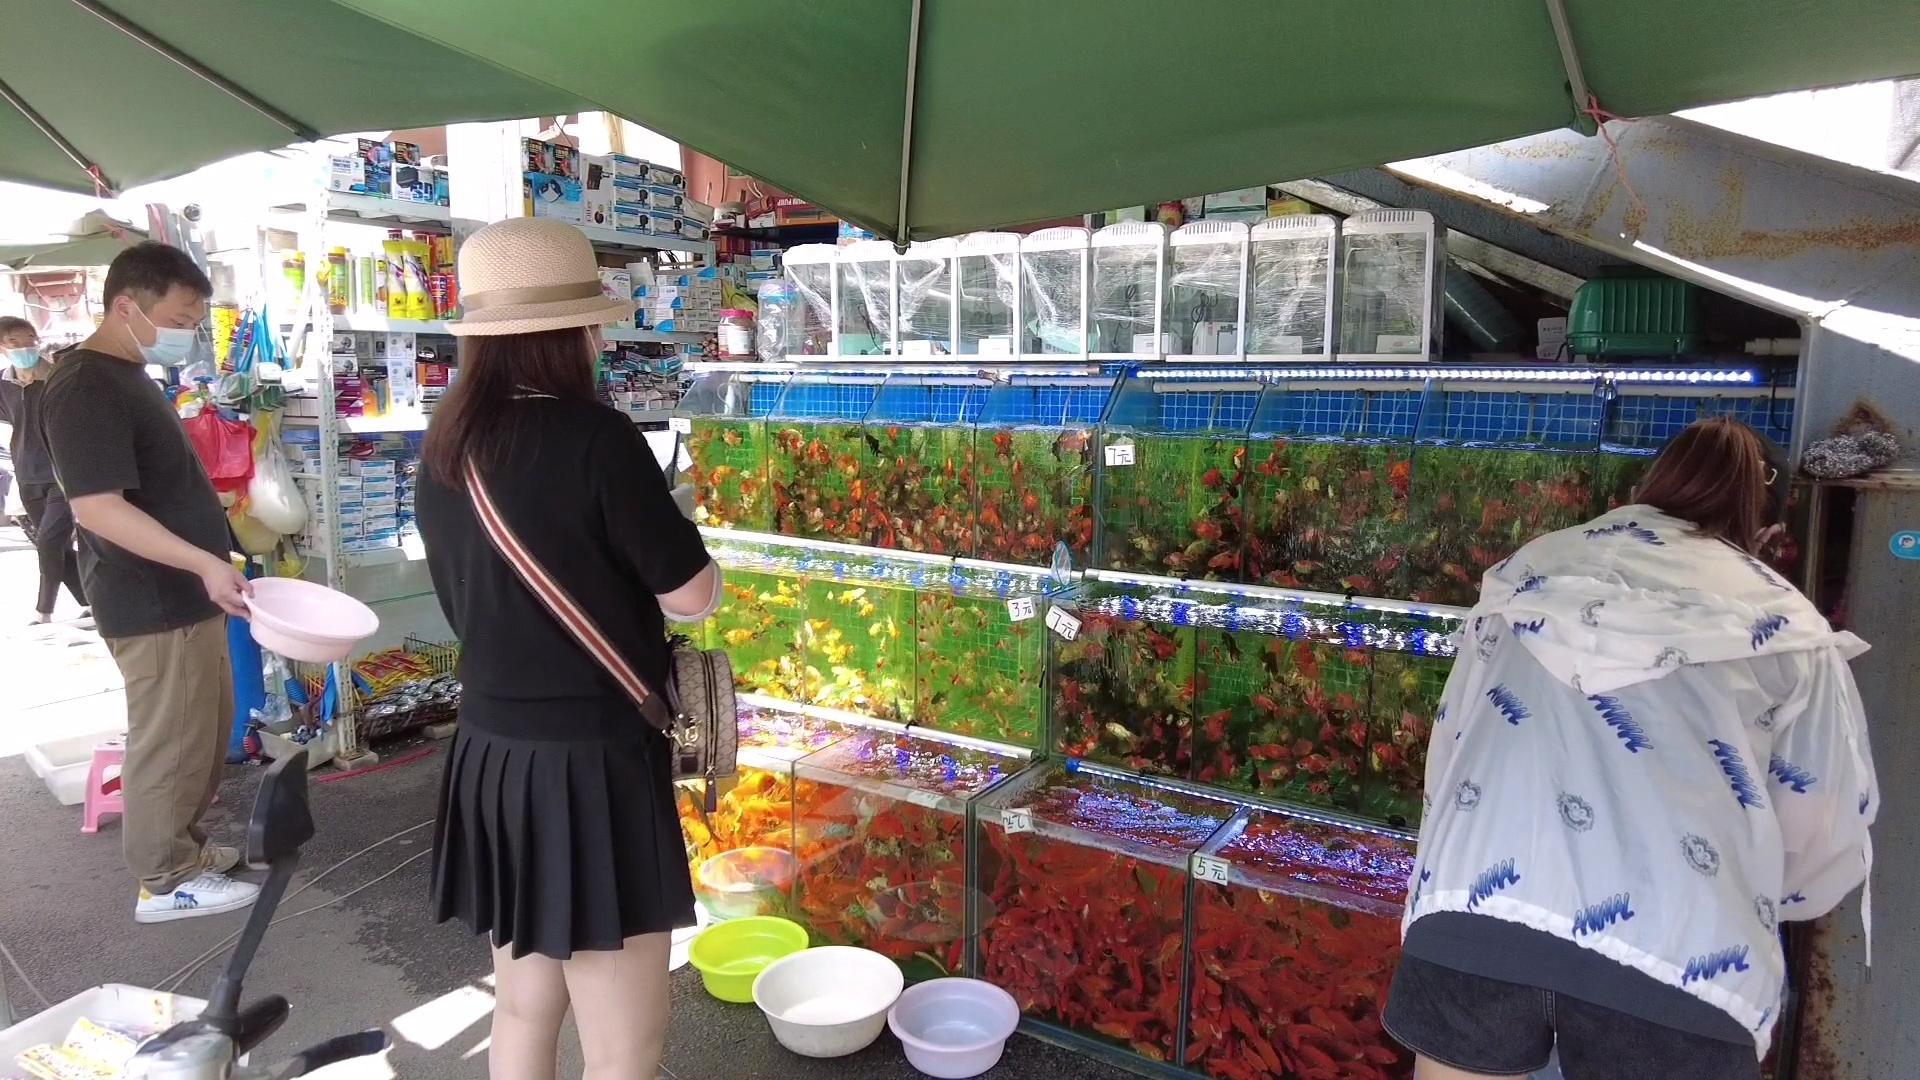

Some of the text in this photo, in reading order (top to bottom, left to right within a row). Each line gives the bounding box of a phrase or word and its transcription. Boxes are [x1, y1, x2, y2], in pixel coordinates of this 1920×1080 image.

[1108, 447, 1132, 465] 7元
[1011, 602, 1032, 617] 3元
[1052, 610, 1076, 640] 7元
[1587, 694, 1655, 753] ANIMAL
[1194, 856, 1227, 880] 5元
[1467, 857, 1521, 913] ANIMAL
[1572, 891, 1635, 938] ANIMAL
[1681, 944, 1750, 986] ANIMAL
